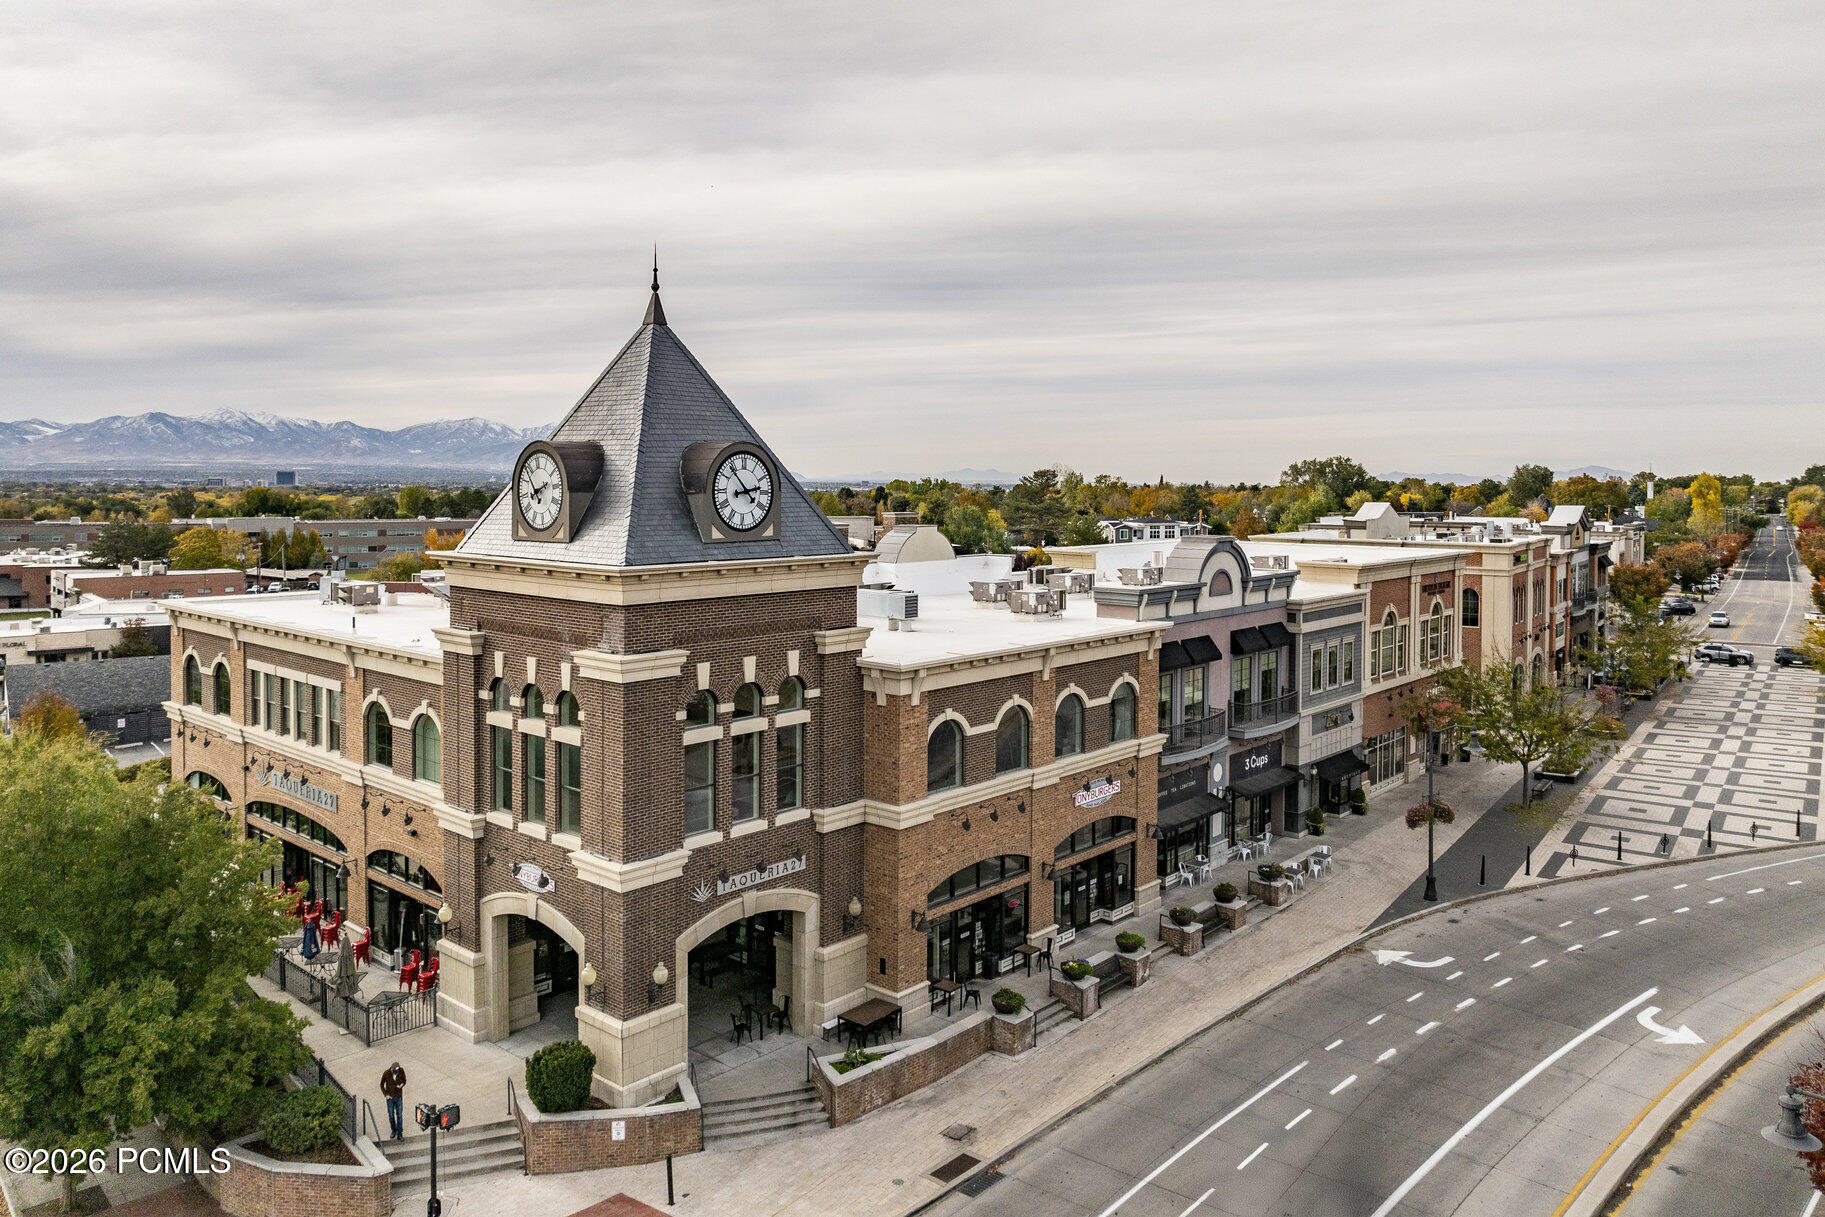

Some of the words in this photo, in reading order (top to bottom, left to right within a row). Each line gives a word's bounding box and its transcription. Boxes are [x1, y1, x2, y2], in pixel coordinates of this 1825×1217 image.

[1244, 758, 1250, 770] 3
[1251, 754, 1269, 768] Cups
[1072, 781, 1120, 805] TONYBURGERS
